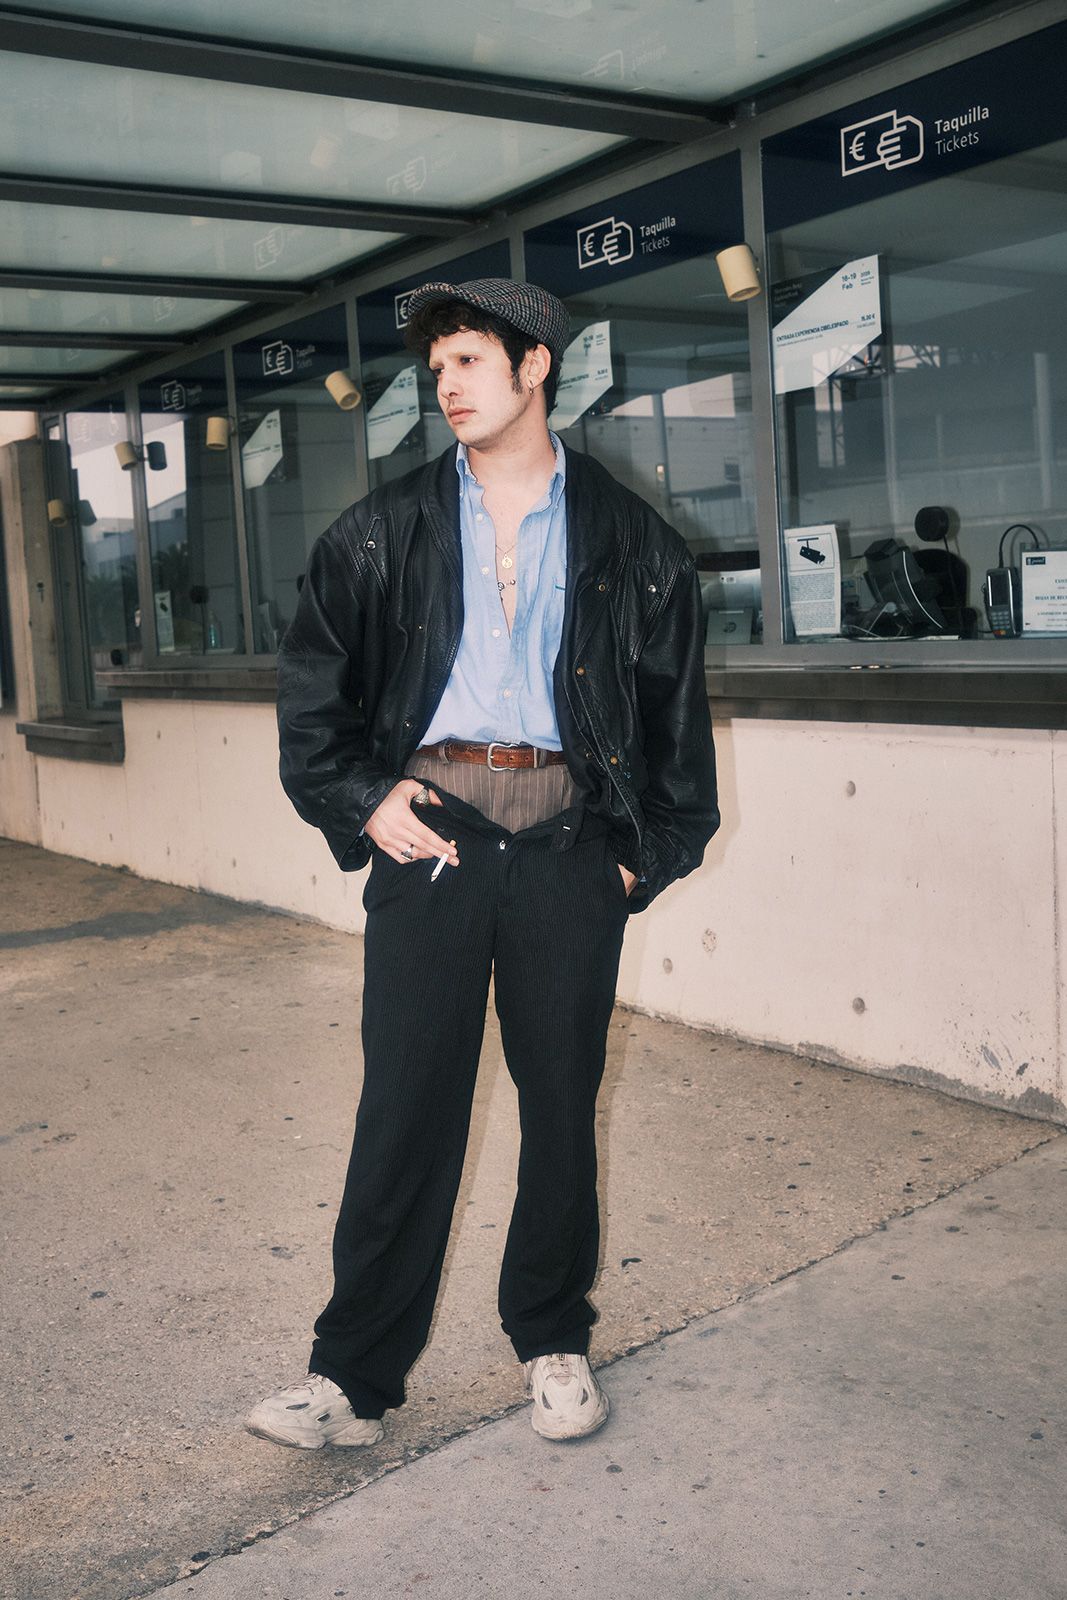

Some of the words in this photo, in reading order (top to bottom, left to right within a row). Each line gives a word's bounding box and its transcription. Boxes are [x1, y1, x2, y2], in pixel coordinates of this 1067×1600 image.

[934, 105, 990, 134] Taquilla
[935, 131, 980, 155] Tickets
[639, 215, 676, 238] Taquilla
[640, 236, 670, 255] Tickets
